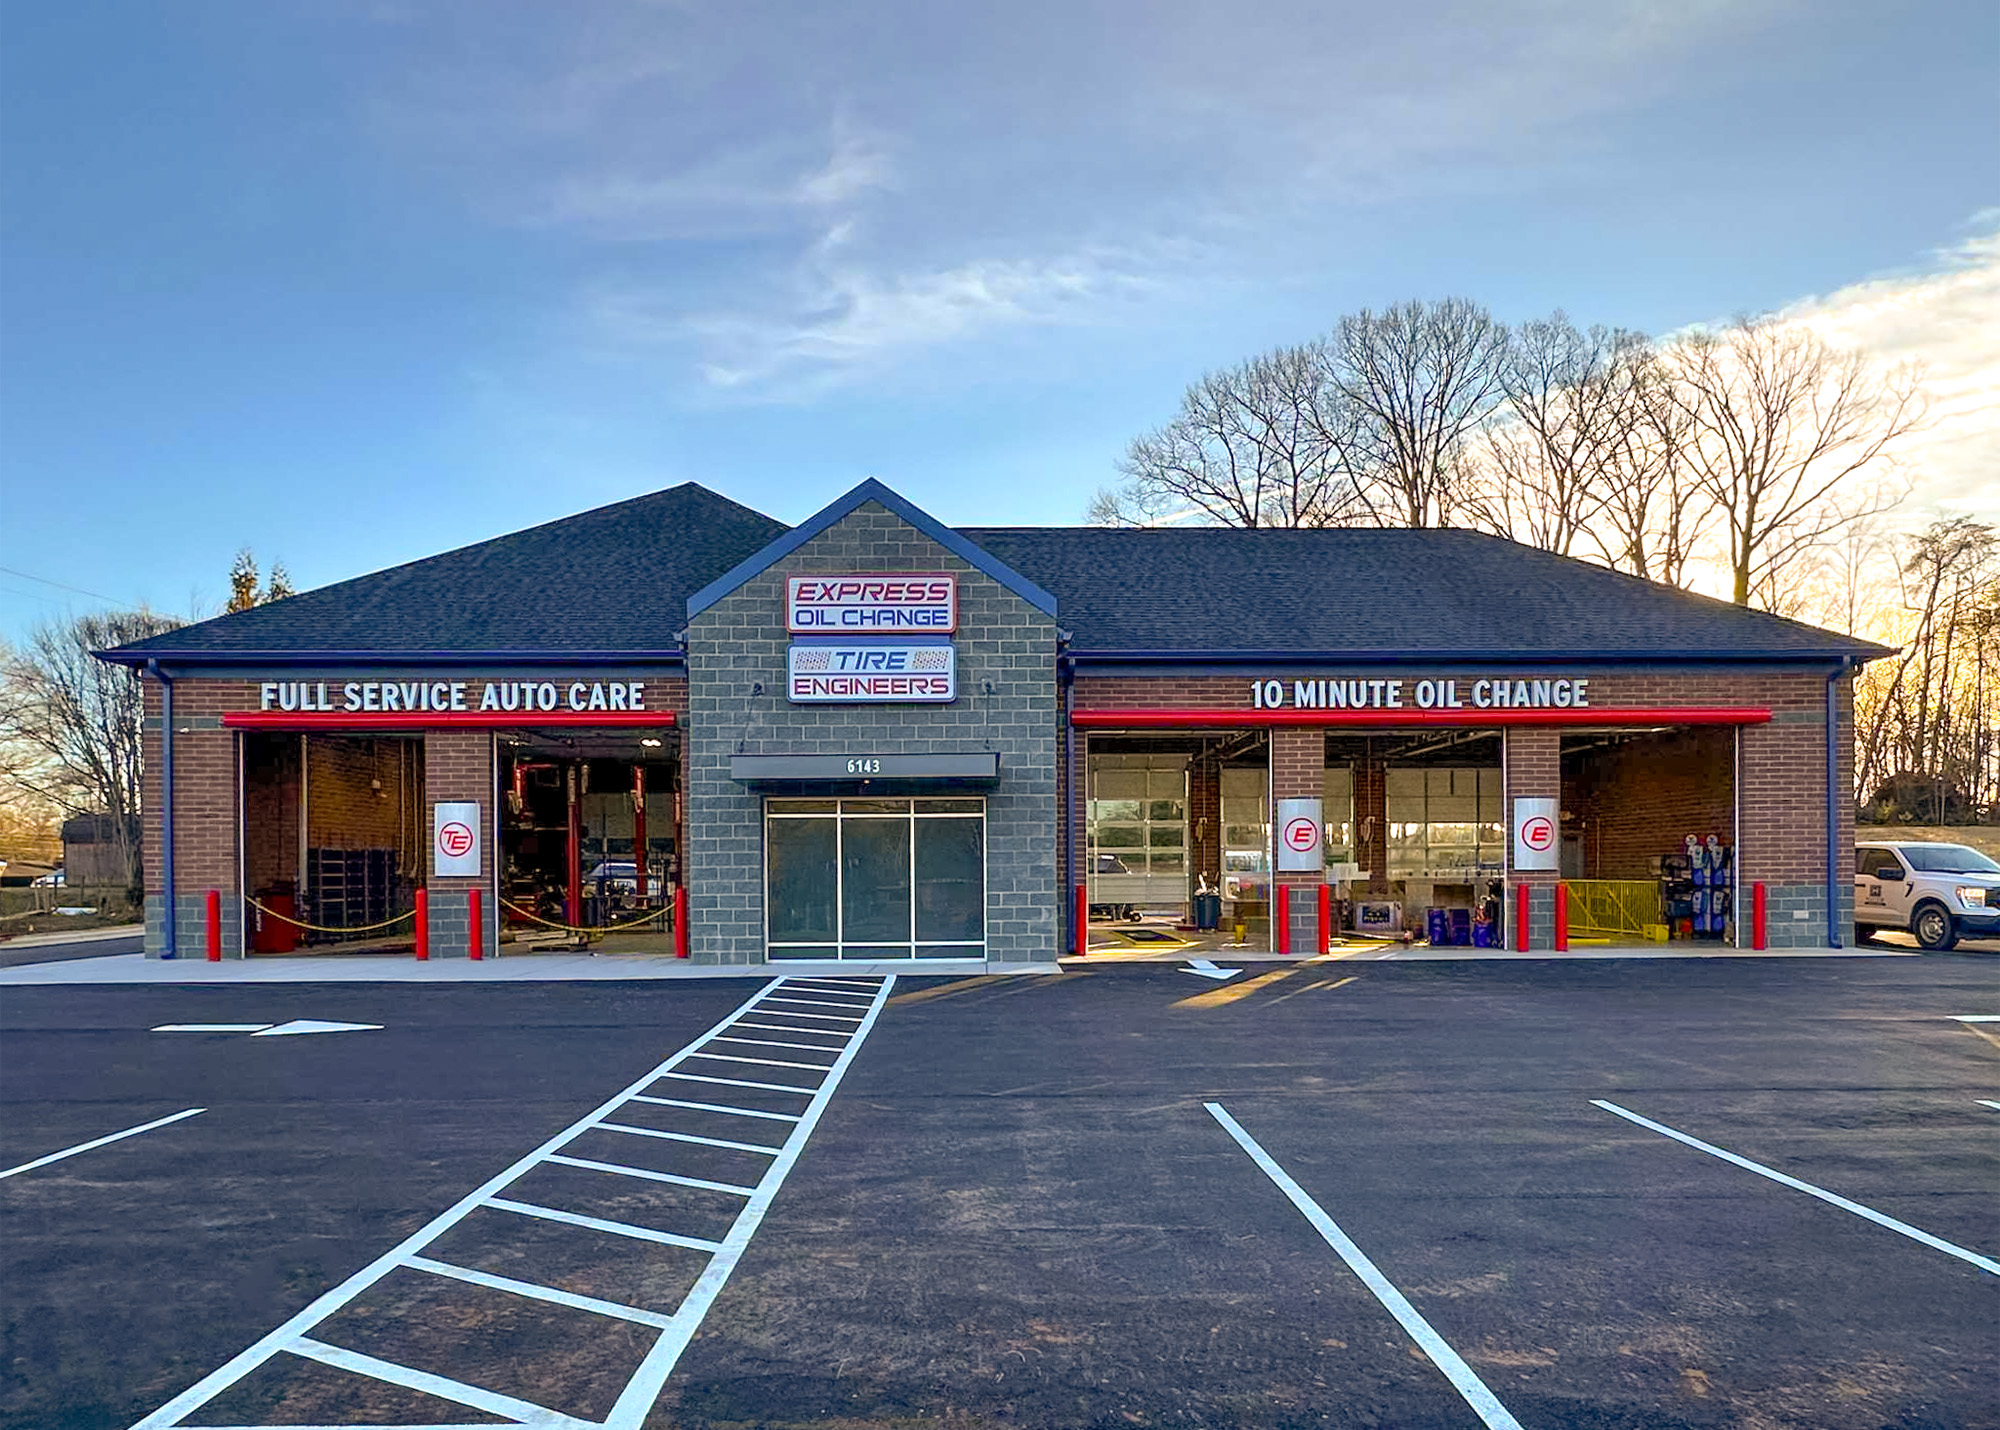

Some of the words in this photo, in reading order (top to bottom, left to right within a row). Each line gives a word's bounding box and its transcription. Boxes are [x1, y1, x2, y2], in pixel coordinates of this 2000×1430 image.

[795, 582, 950, 601] EXPRESS
[795, 609, 836, 626] OIL
[842, 609, 949, 626] CHANGE
[836, 651, 908, 670] TIRE
[794, 678, 949, 695] ENGINEERS
[1251, 679, 1284, 709] 10
[1294, 680, 1403, 709] MINUTE
[1415, 679, 1463, 708] OIL
[1472, 679, 1589, 708] CHANGE
[261, 682, 333, 711] FULL
[343, 682, 467, 711] SERVICE
[480, 682, 557, 711] AUTO
[568, 682, 646, 711] CARE
[846, 759, 881, 774] 6143
[444, 831, 469, 850] TE
[1293, 827, 1312, 842] E
[1531, 826, 1549, 841] E
